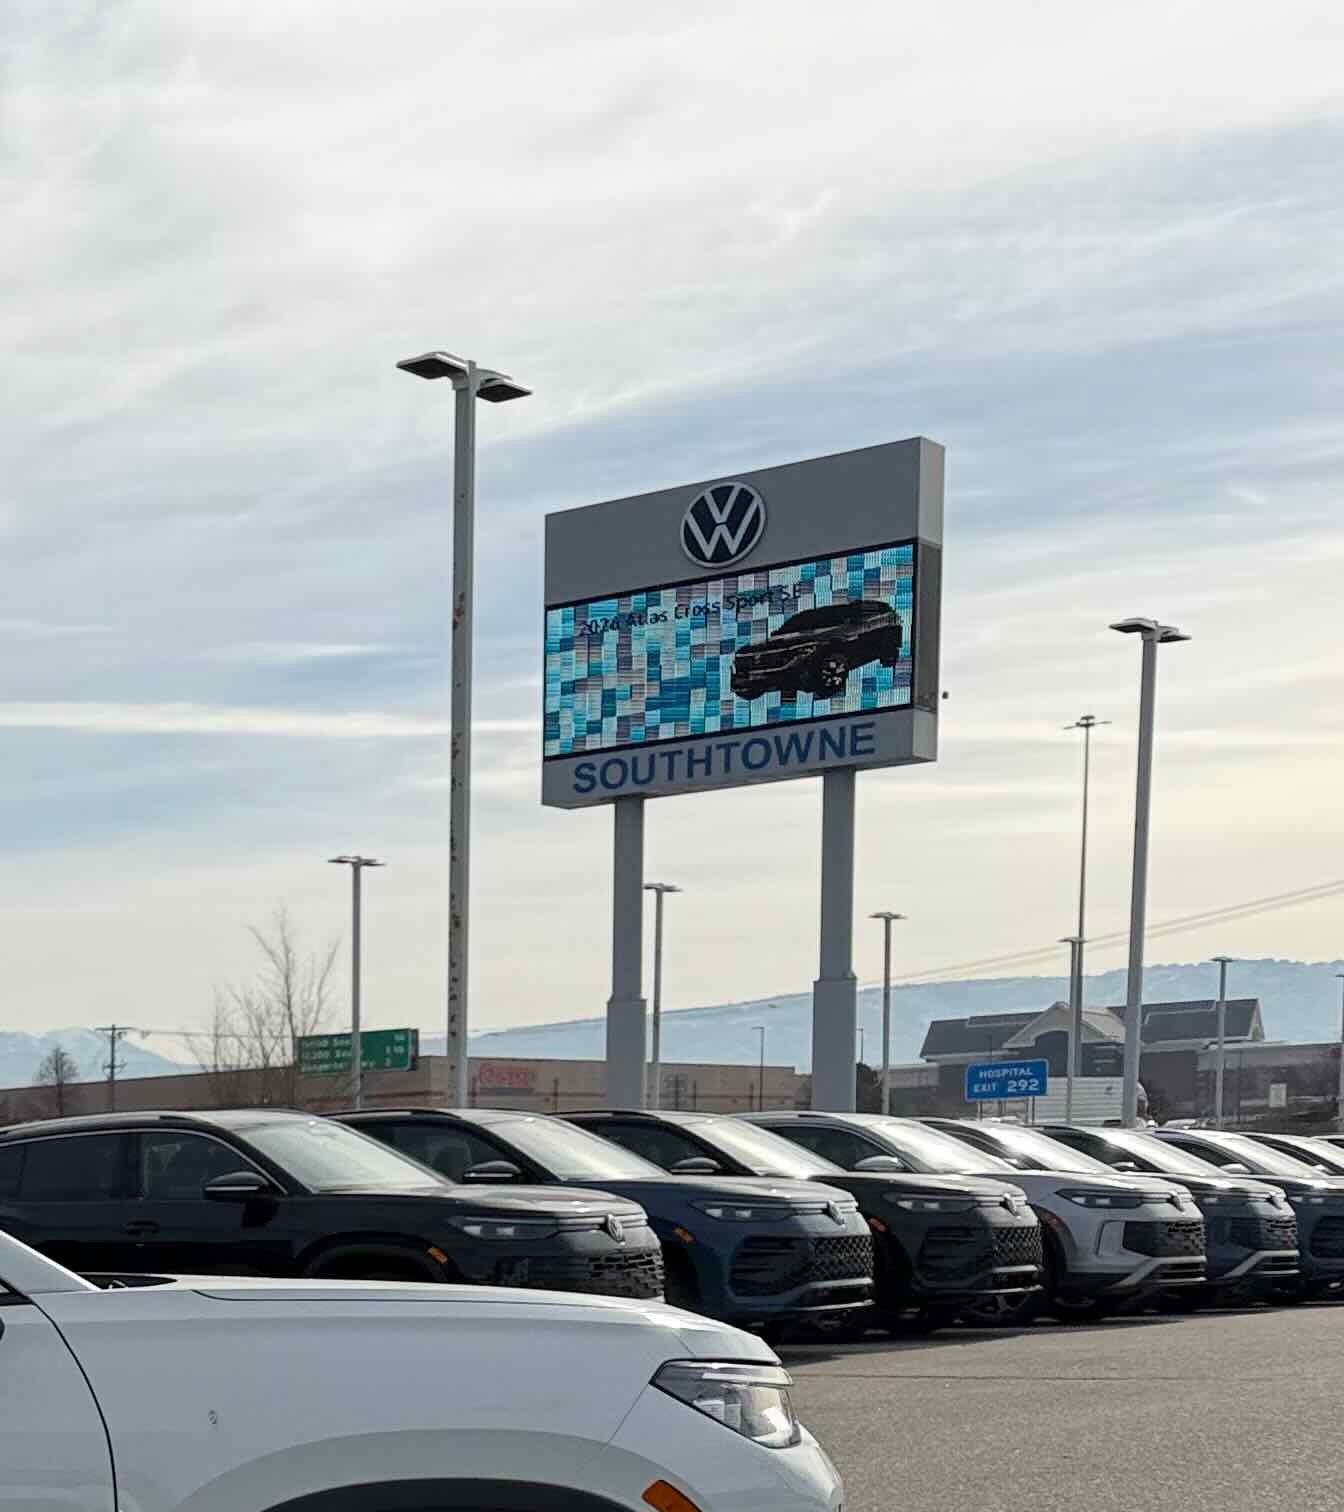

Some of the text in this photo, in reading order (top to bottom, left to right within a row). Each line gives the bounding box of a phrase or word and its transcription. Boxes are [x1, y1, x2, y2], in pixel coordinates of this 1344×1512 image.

[680, 482, 765, 568] VW
[674, 601, 721, 620] Cross
[573, 721, 876, 795] SOUTHTOWNE
[979, 1067, 1033, 1079] HOSPITAL
[973, 1079, 1040, 1093] EXIT 292
